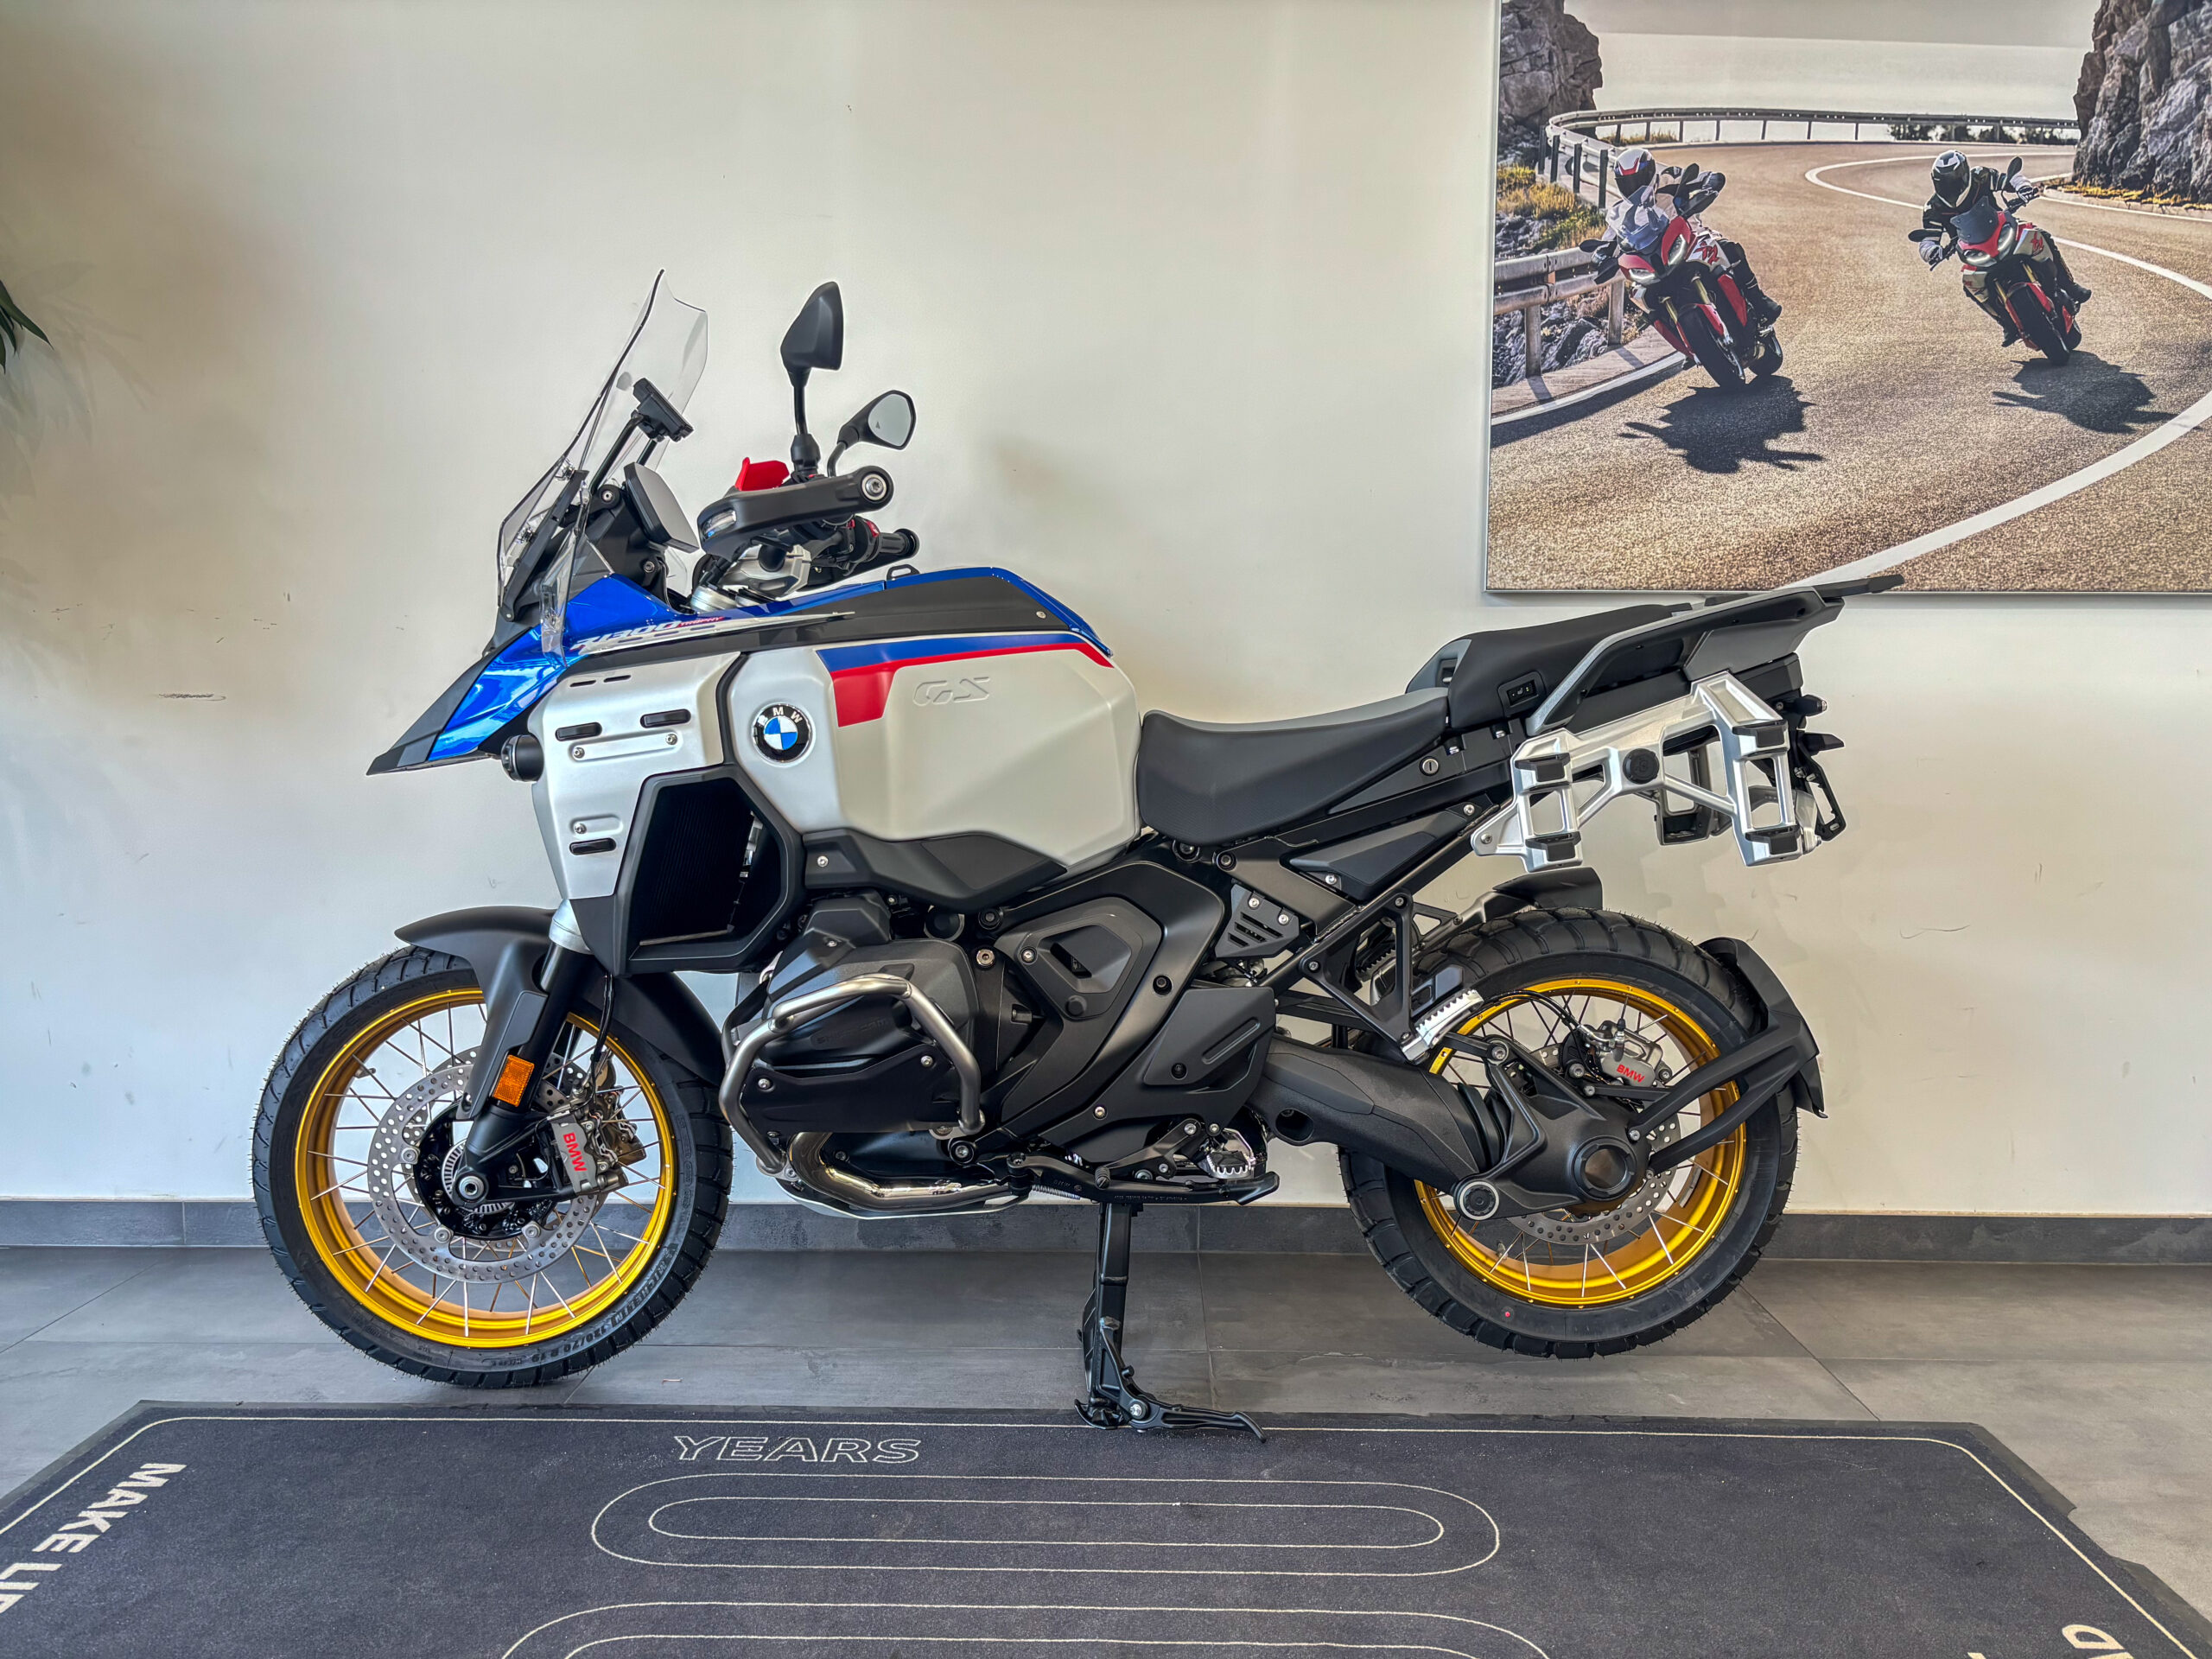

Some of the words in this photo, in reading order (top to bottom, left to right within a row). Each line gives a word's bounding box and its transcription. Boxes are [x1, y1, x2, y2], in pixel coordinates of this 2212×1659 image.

[913, 677, 990, 706] GS
[757, 707, 803, 726] BMW
[1617, 1064, 1645, 1083] BMW
[563, 1132, 588, 1172] BMW
[674, 1435, 922, 1463] YEARS
[31, 1463, 188, 1553] MAKE
